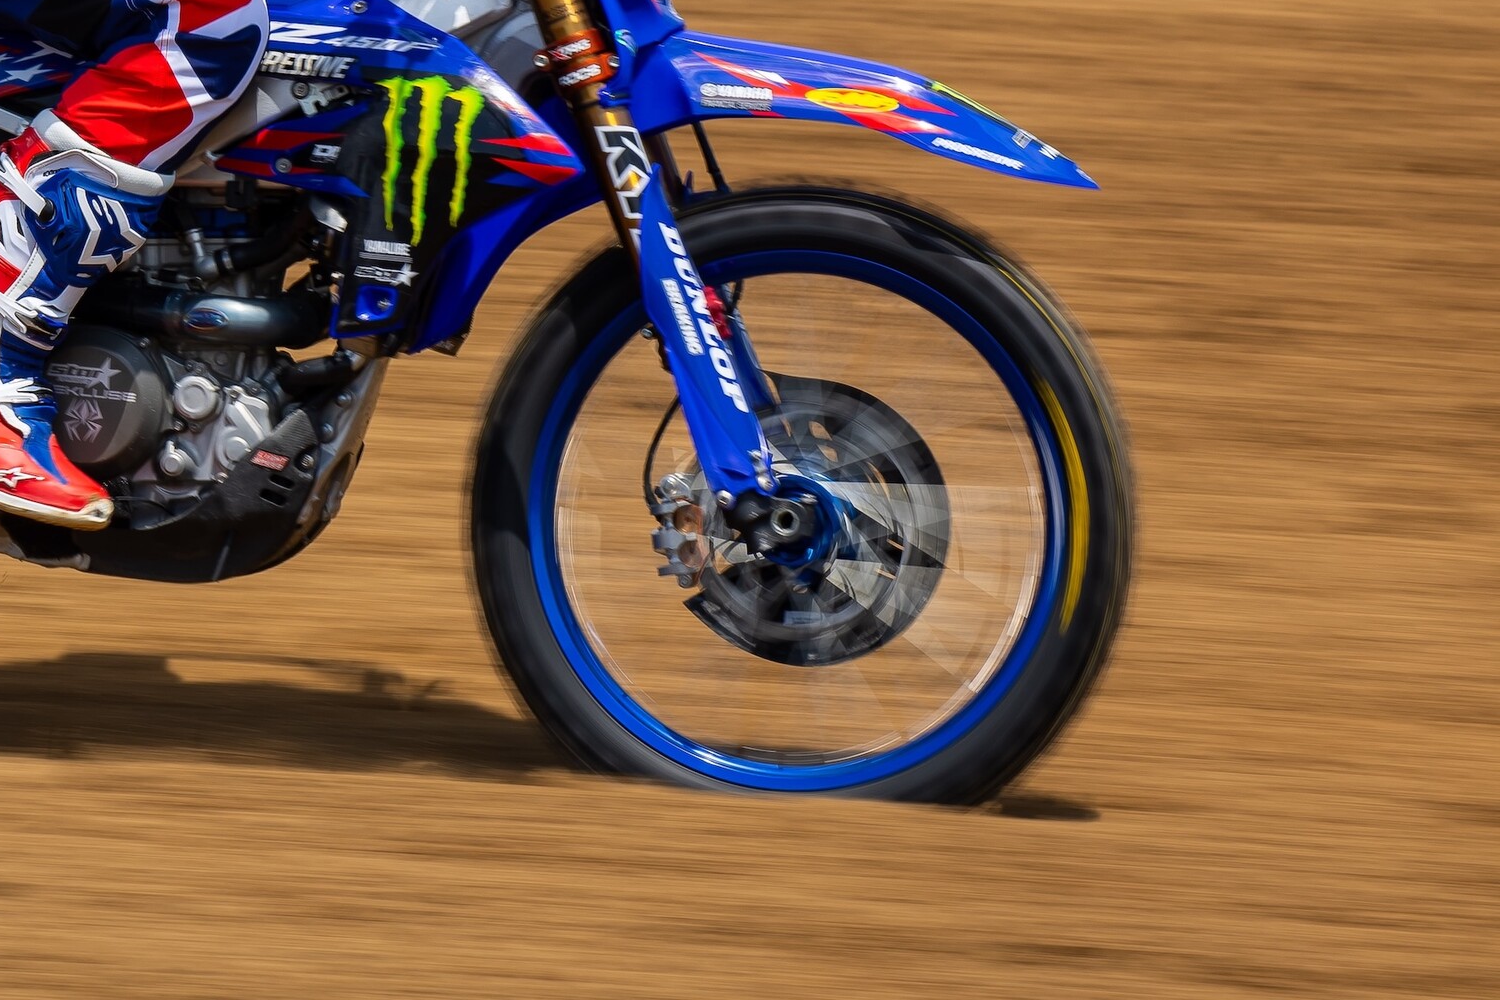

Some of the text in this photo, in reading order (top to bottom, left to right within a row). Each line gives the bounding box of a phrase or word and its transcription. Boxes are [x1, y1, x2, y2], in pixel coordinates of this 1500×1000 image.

[658, 221, 750, 414] DUNLOP
[660, 278, 705, 357] BRAKING
[53, 384, 138, 403] EKLUSE
